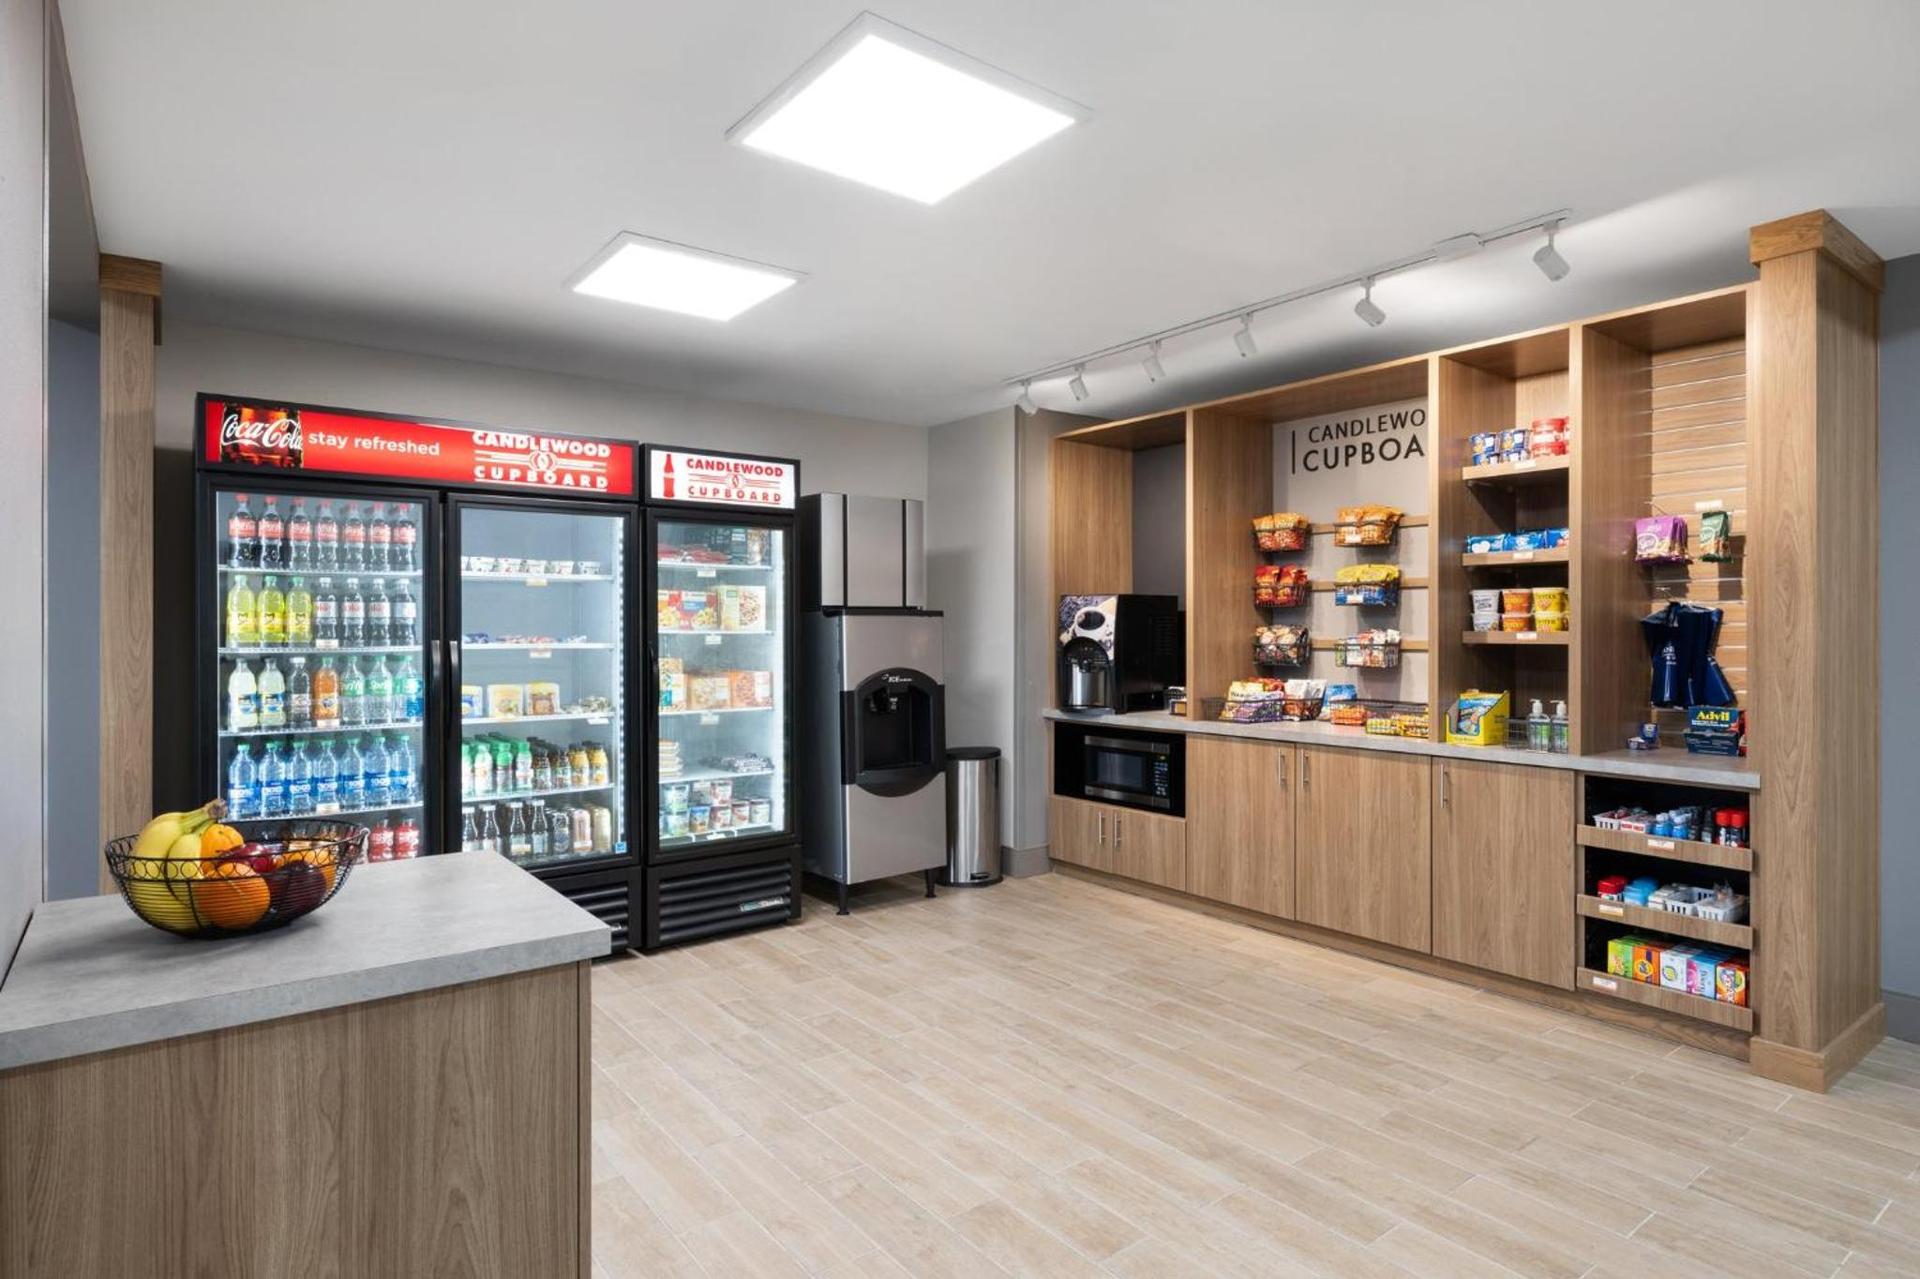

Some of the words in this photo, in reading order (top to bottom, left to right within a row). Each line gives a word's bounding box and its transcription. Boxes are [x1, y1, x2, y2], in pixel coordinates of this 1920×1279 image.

[220, 412, 304, 451] Coca-Cola
[1309, 408, 1426, 443] CANDLEWO
[308, 431, 348, 450] stay
[353, 434, 440, 457] refreshed
[472, 431, 611, 458] CANDLEWOOD
[1303, 433, 1425, 472] CUPBOA
[473, 464, 608, 489] CUPBOARD
[687, 458, 784, 477] CANDLEWOOD
[688, 485, 781, 502] CUPBOARD
[1696, 710, 1731, 721] Advil
